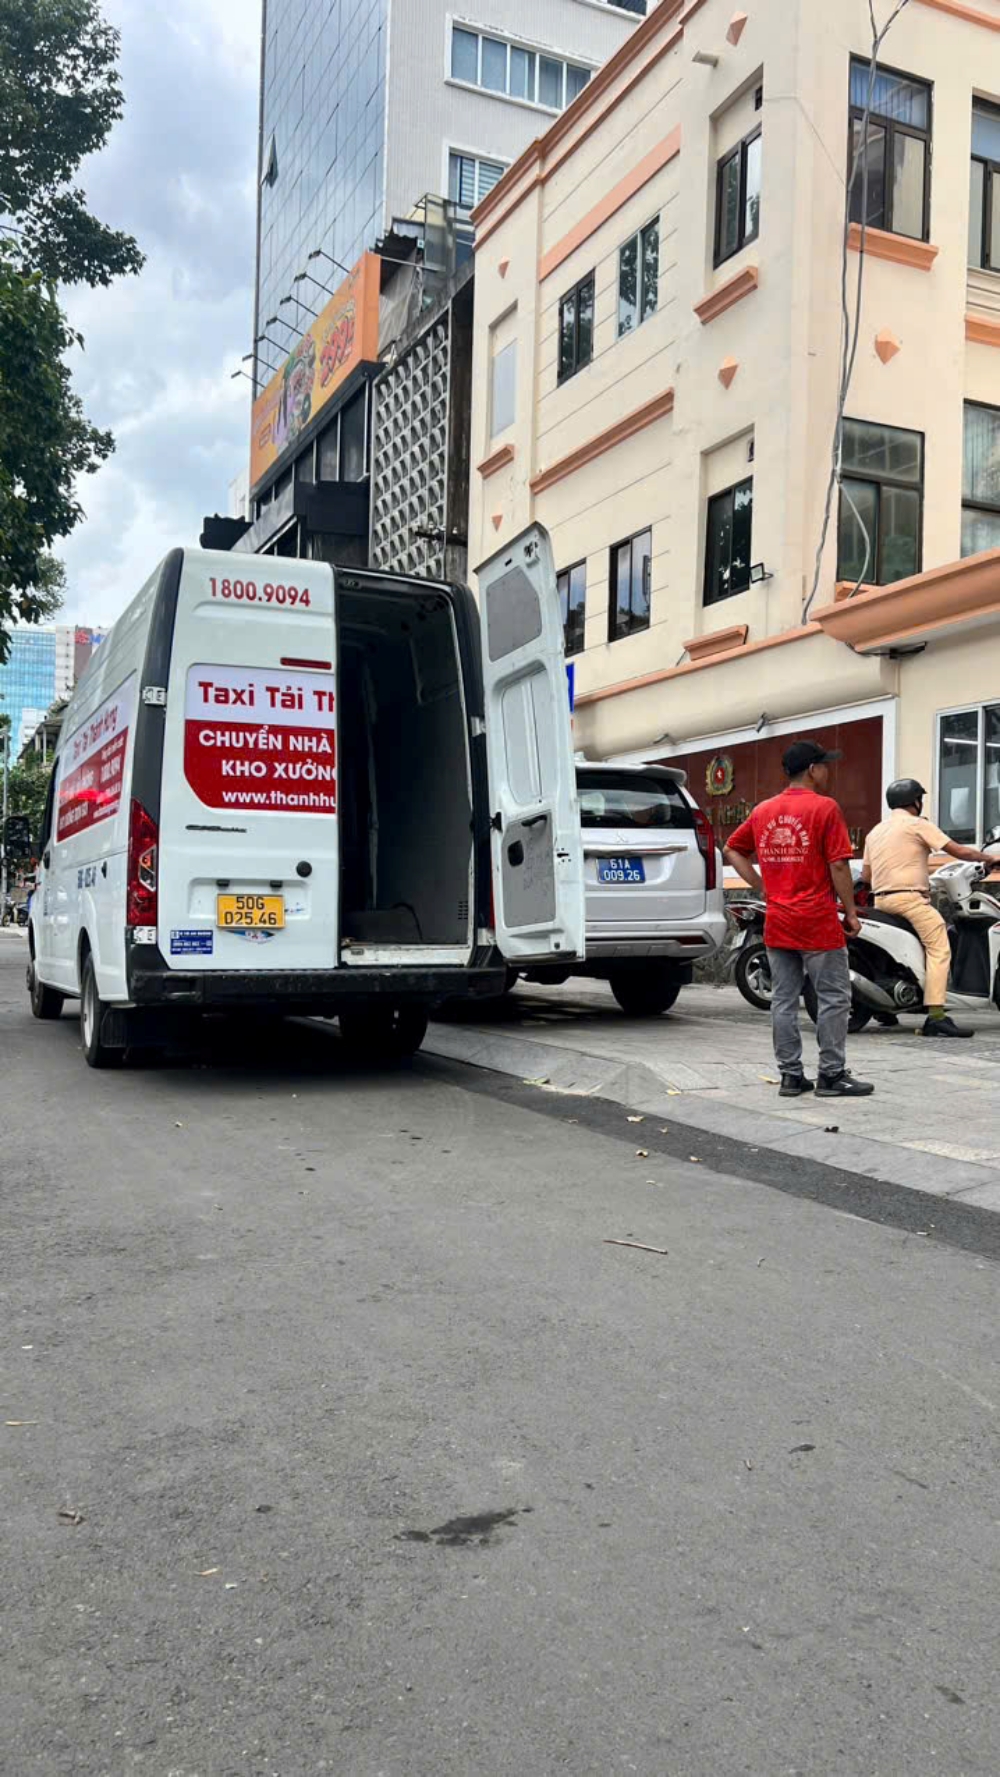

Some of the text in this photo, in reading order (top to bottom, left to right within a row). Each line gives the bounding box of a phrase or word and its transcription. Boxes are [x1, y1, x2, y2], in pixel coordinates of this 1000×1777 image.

[210, 577, 311, 607] 1800.9094
[198, 681, 255, 707] Taxi
[265, 685, 304, 710] Tải
[198, 724, 332, 754] CHUYỂN NHÀ
[221, 759, 267, 778] KHO
[603, 869, 641, 881] 009.26
[236, 896, 265, 911] 50G
